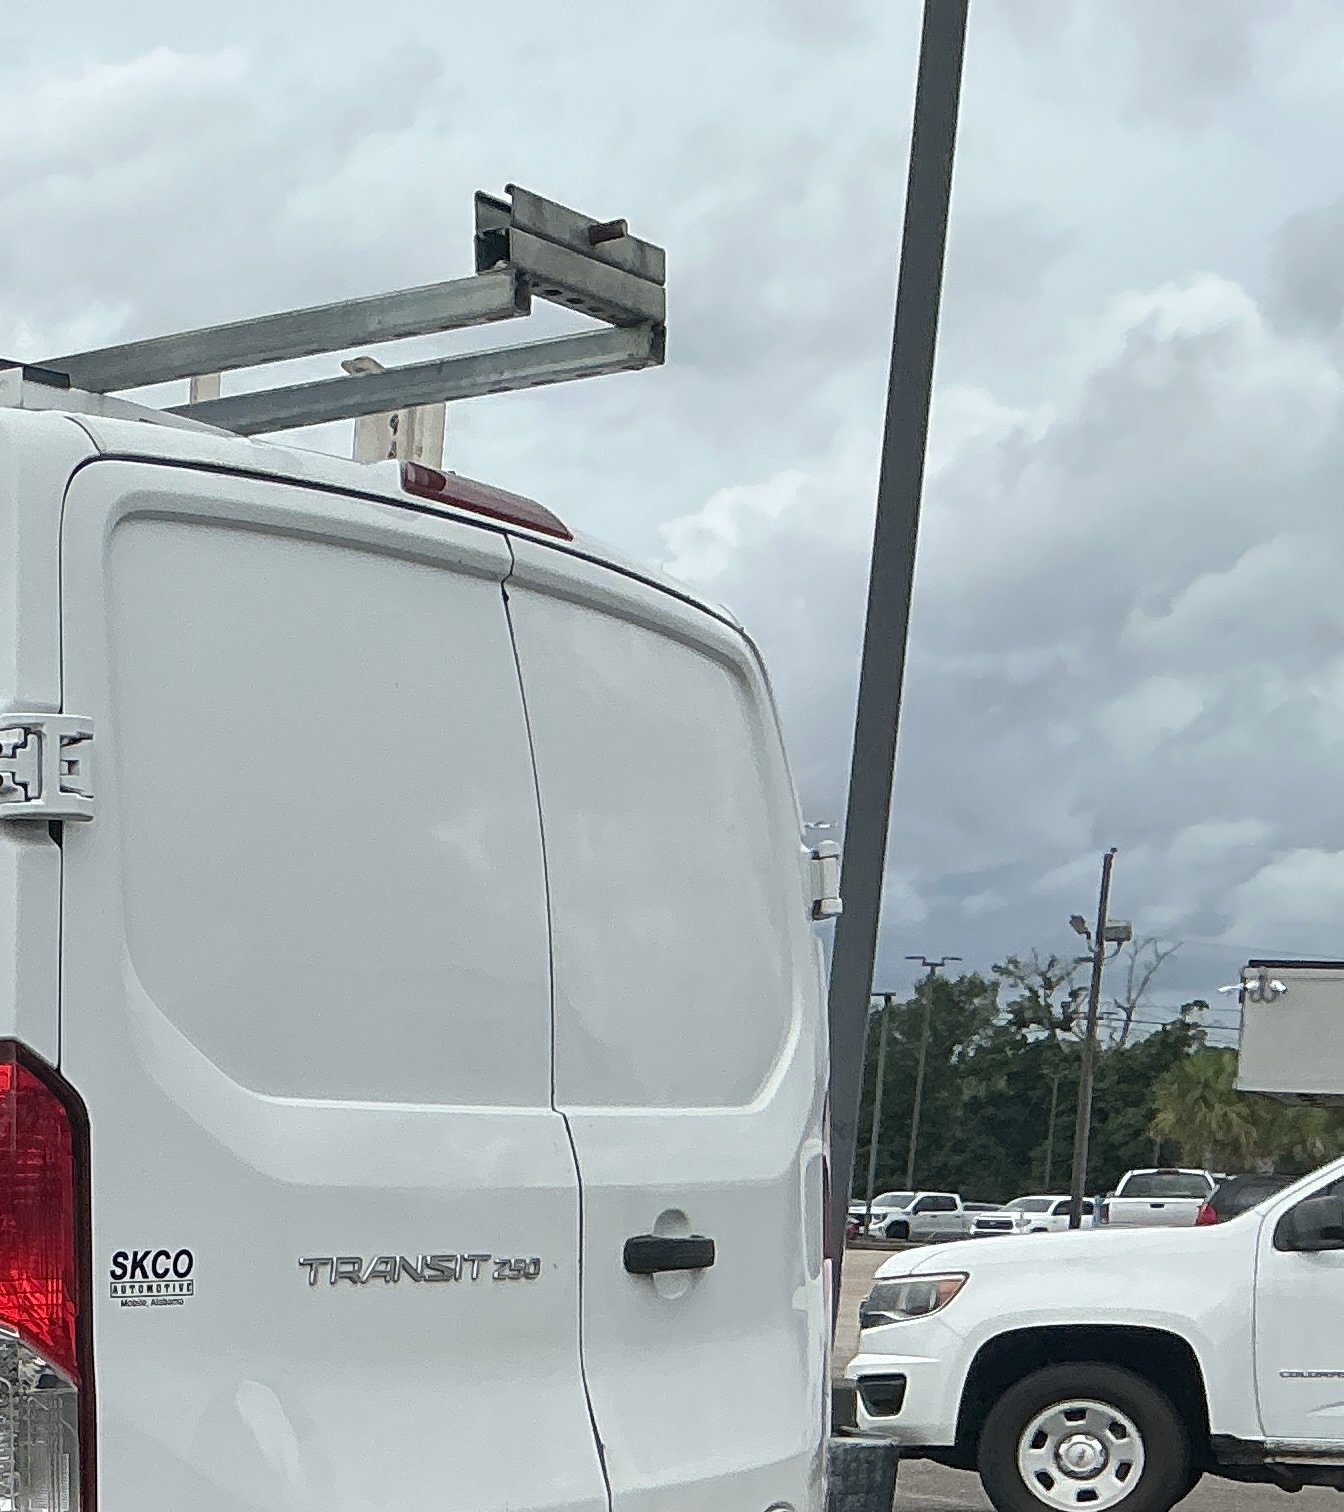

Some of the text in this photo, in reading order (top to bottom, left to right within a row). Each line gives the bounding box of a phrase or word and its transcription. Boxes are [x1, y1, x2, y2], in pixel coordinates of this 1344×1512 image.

[110, 1249, 193, 1280] SKCO
[298, 1253, 491, 1285] TRANSIT
[112, 1283, 192, 1294] AUTOMOTIVE
